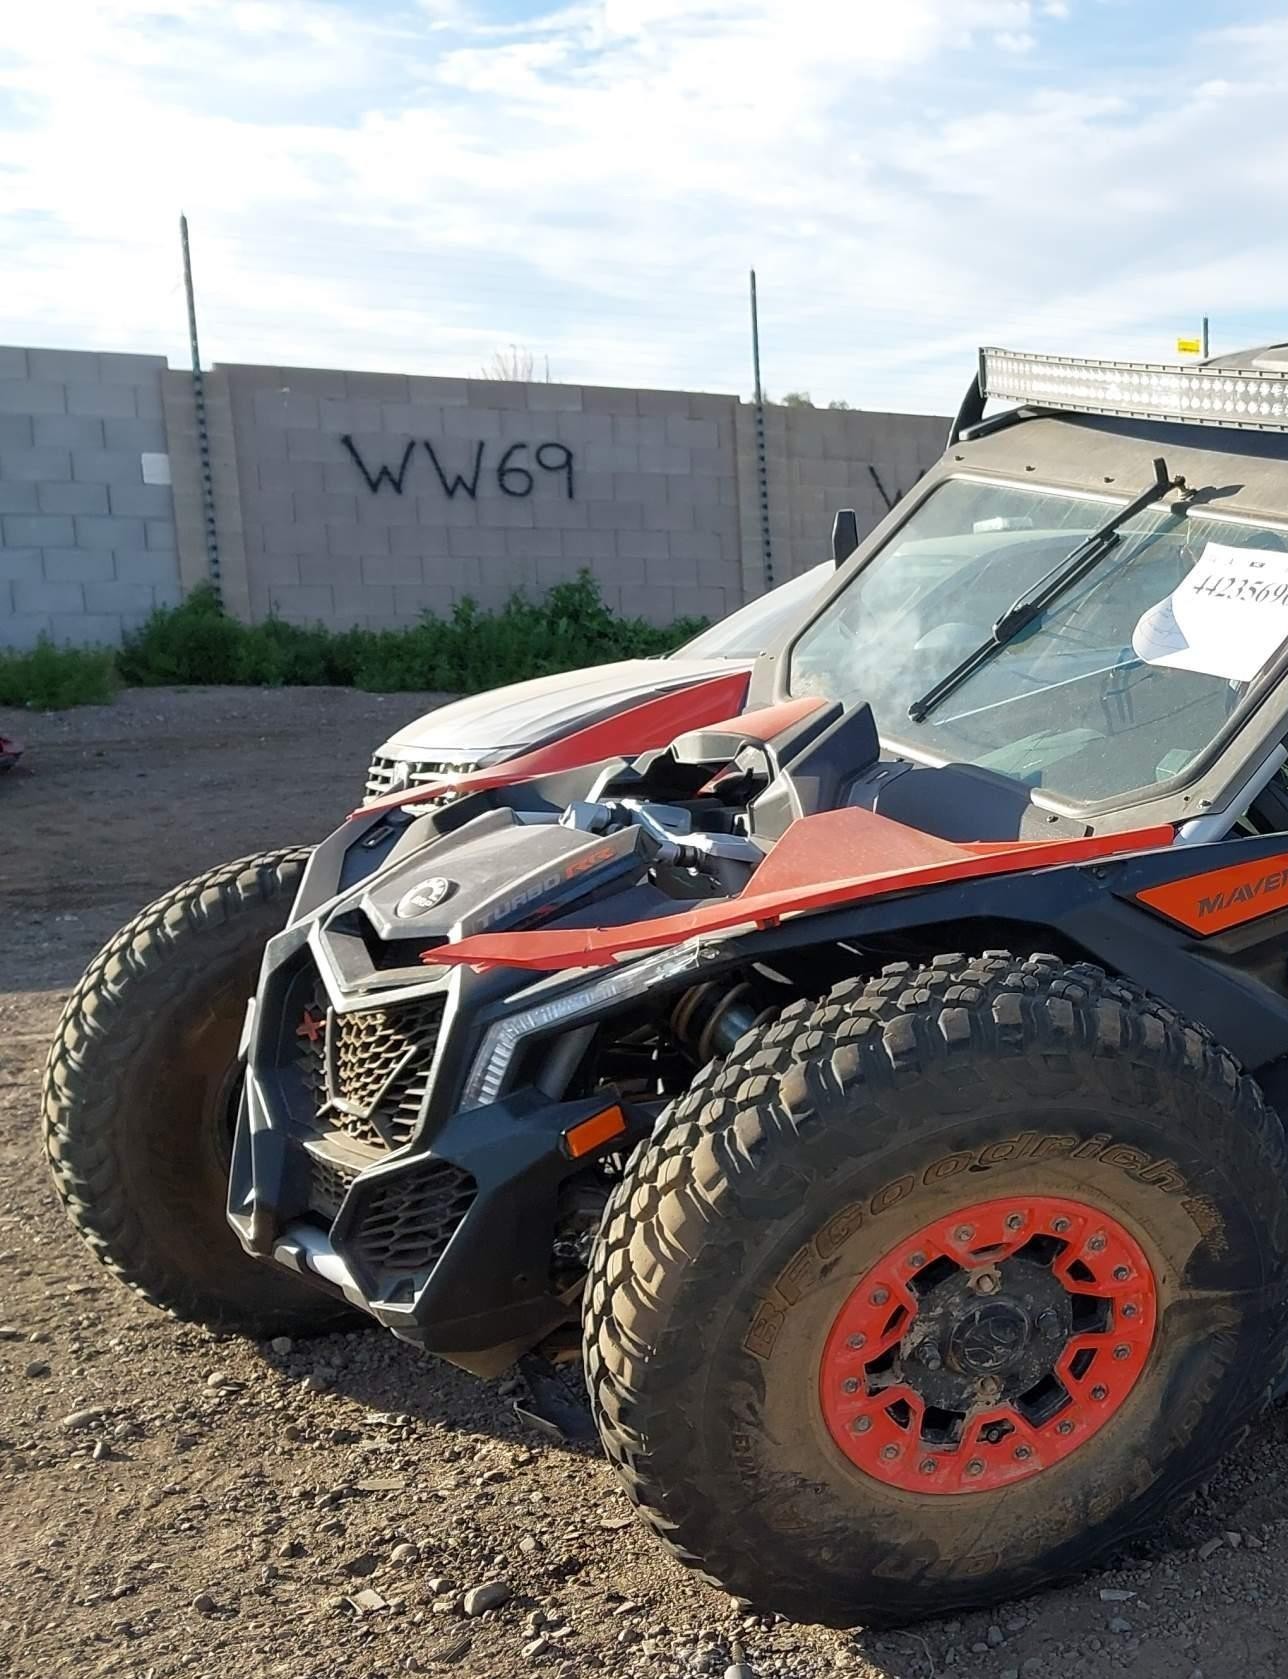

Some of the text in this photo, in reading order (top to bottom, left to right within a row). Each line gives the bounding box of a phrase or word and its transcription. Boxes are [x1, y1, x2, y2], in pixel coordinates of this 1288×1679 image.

[340, 434, 575, 499] WW69
[477, 847, 617, 929] TURBO RR
[743, 1130, 1188, 1360] BFGoodrich
